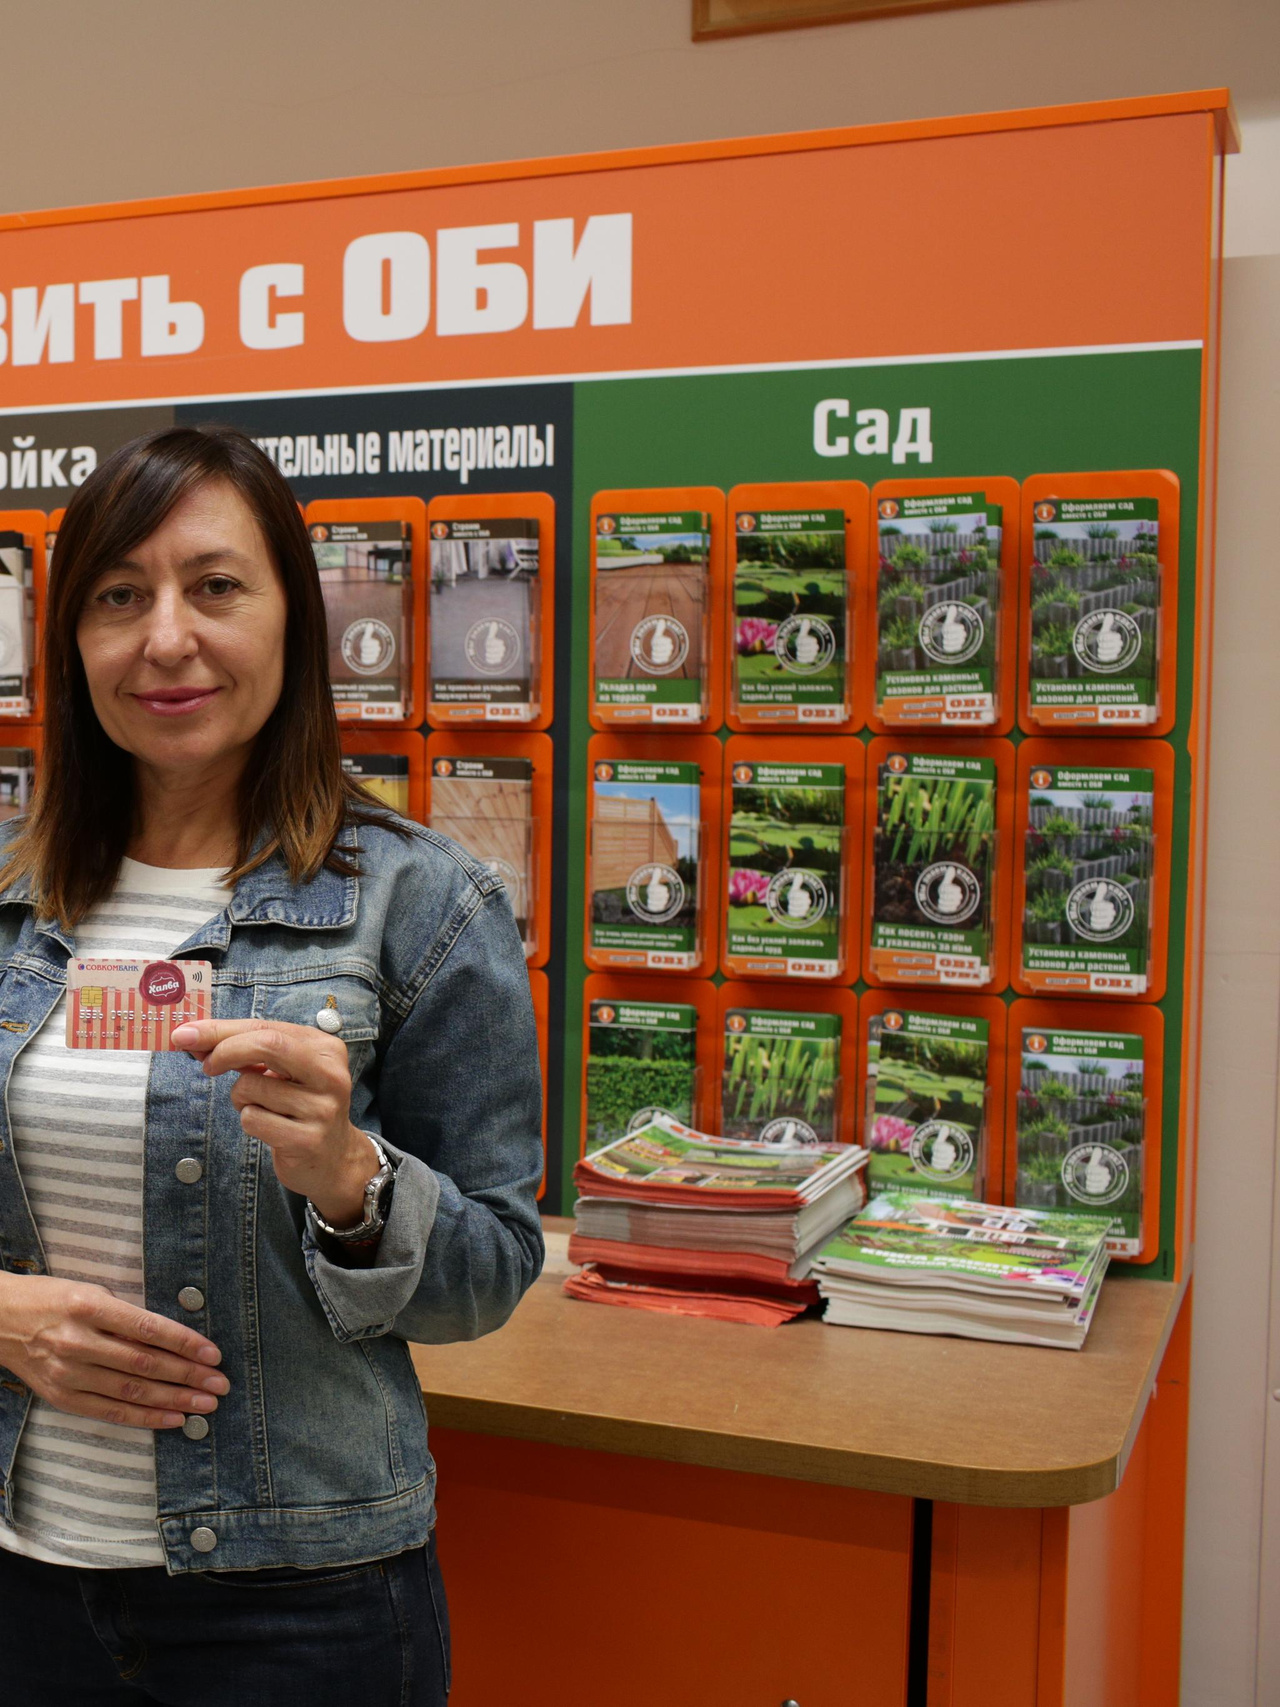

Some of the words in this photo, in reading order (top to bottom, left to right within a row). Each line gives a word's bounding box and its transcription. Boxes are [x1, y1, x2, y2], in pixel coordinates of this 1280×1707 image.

[238, 262, 305, 350] с
[342, 212, 634, 343] ОБИ
[387, 423, 555, 485] материалы
[813, 397, 934, 465] Сад
[85, 963, 139, 972] СОВКОМБАНК
[148, 980, 180, 995] Халва
